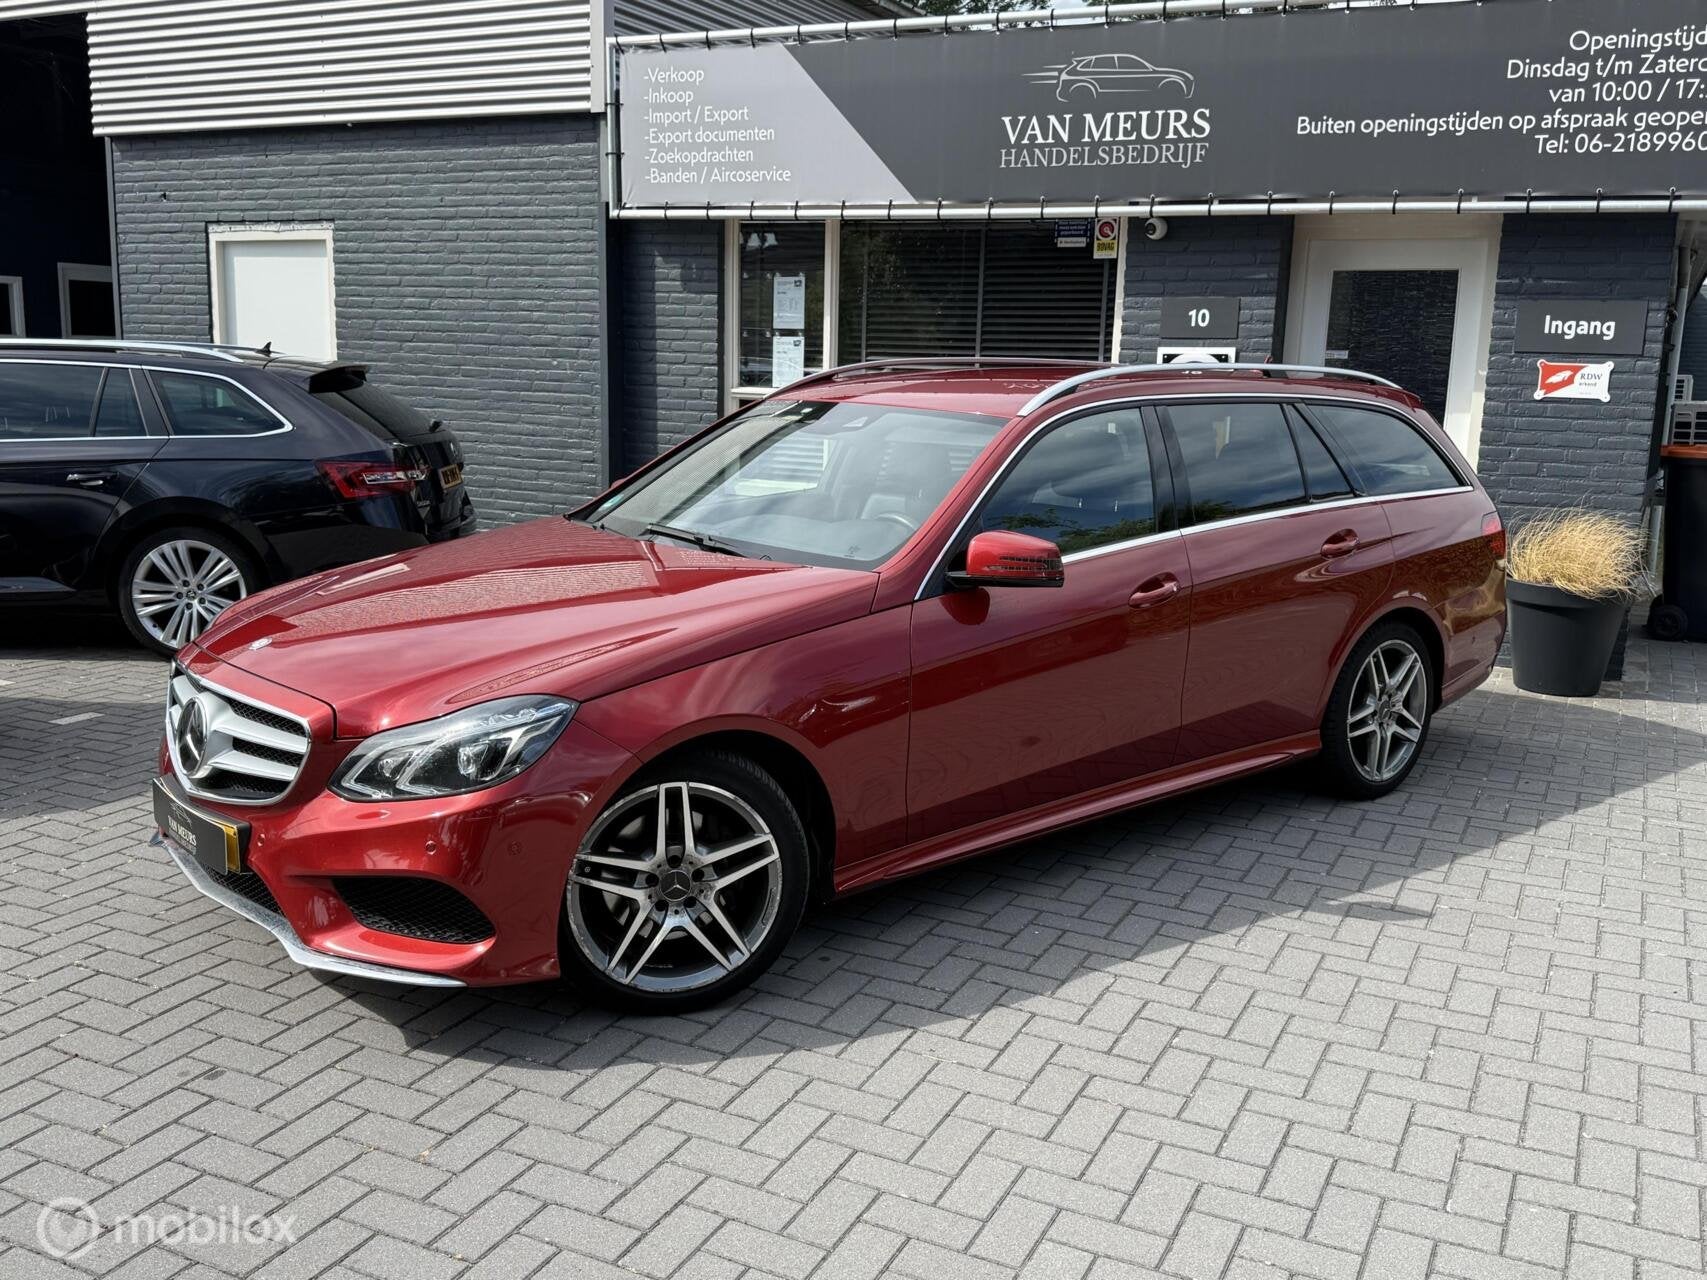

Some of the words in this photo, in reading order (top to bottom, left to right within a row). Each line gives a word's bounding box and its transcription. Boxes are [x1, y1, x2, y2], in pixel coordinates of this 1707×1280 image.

[1507, 56, 1590, 82] Dinsdag
[1596, 54, 1633, 78] t/m
[1549, 87, 1585, 103] van
[1592, 79, 1652, 102] 10:00
[1656, 78, 1670, 102] /
[1675, 78, 1707, 99] 17:
[694, 105, 701, 124] /
[704, 105, 749, 124] Export
[1000, 114, 1073, 144] VAN
[1081, 108, 1211, 142] MEURS
[1297, 115, 1355, 134] Buiten
[1360, 110, 1504, 137] openingstijden
[1509, 114, 1536, 134] op
[1541, 106, 1629, 133] afspraak
[695, 127, 775, 143] documenten
[1534, 132, 1569, 154] Tel:
[999, 143, 1209, 168] HANDELSBEDRIJF
[700, 167, 708, 185] /
[710, 166, 792, 183] Aircoservice
[1188, 308, 1211, 328] 10
[1543, 314, 1616, 341] Ingang
